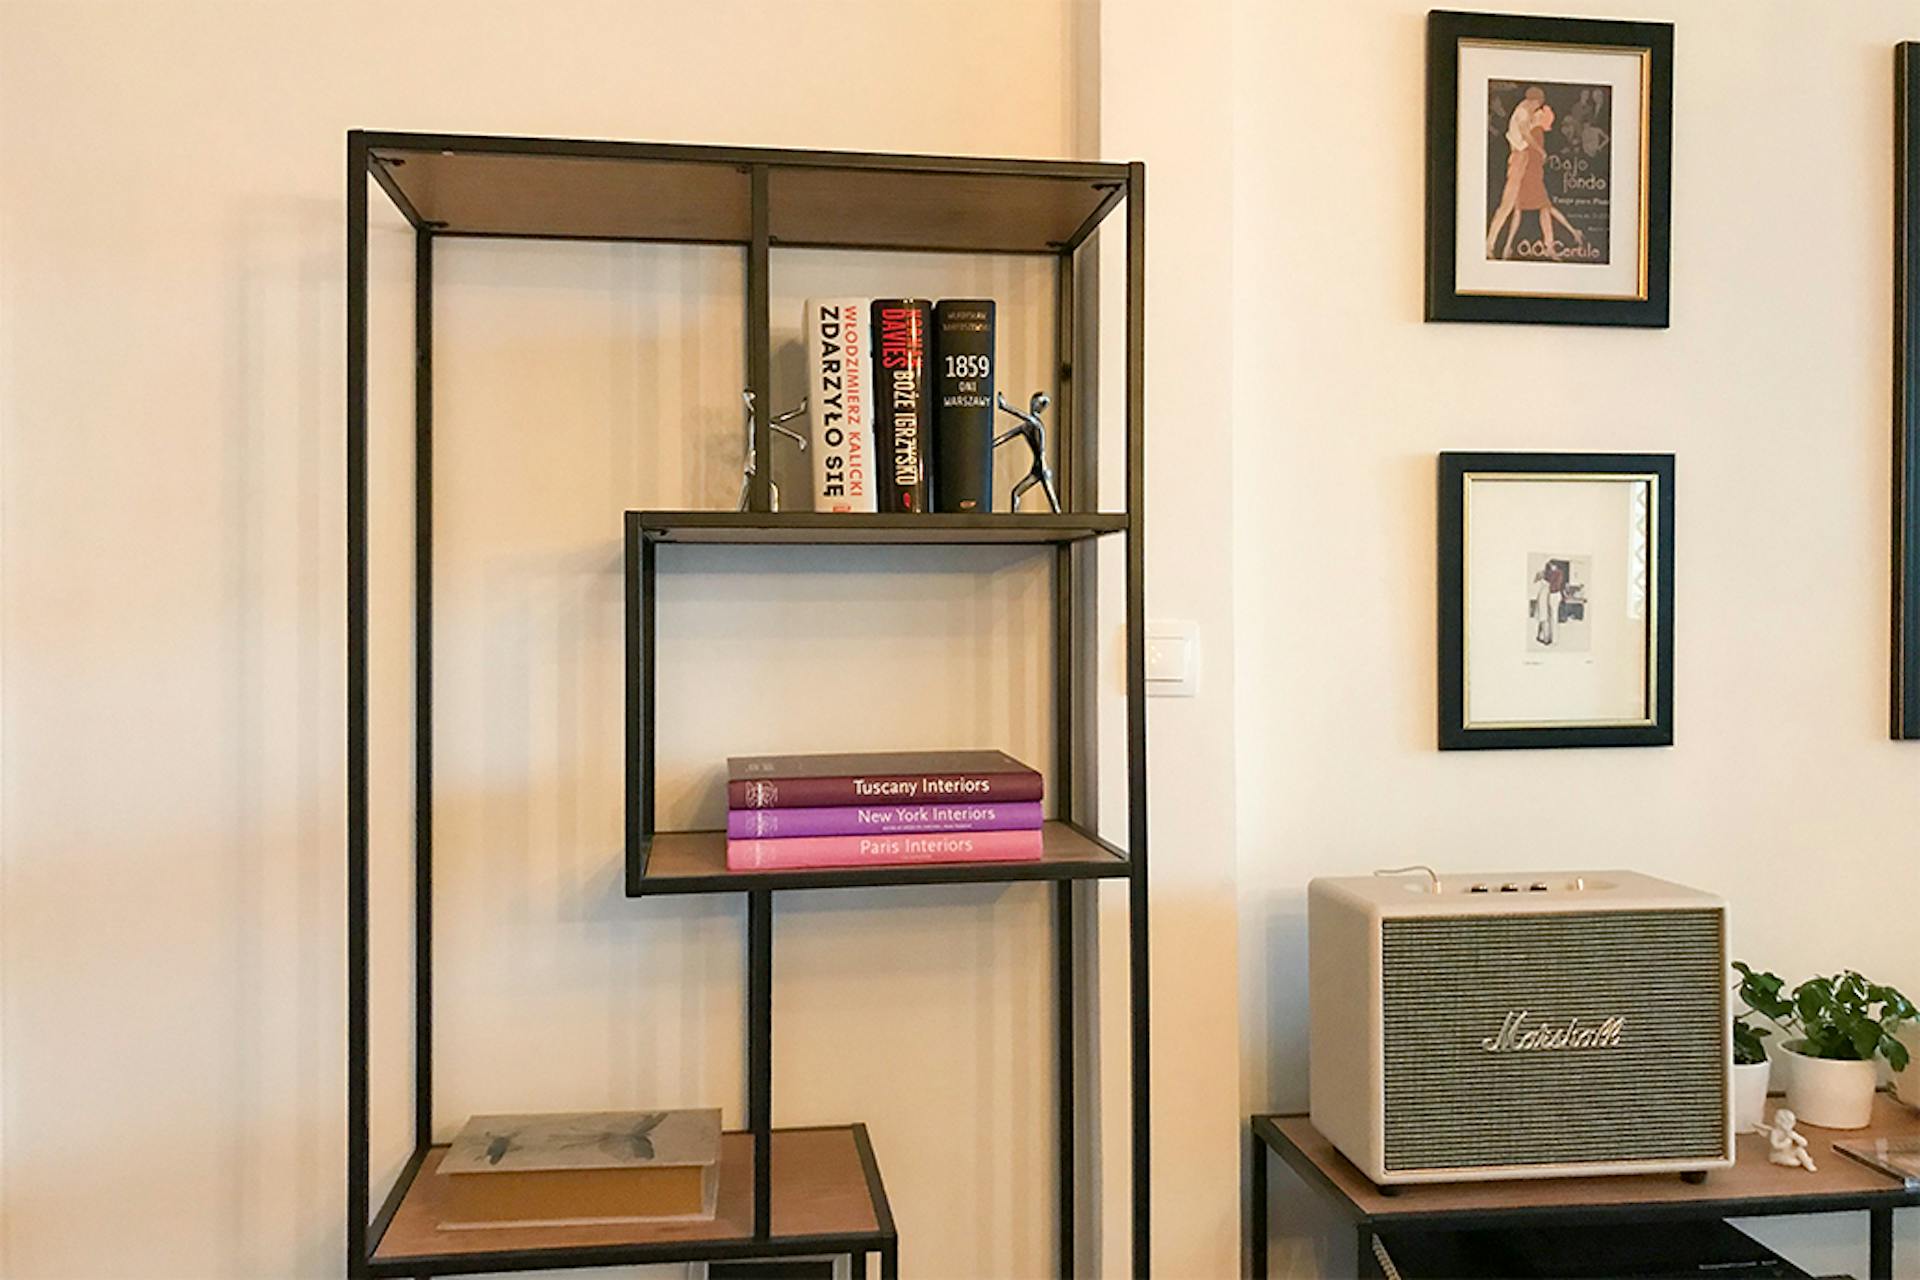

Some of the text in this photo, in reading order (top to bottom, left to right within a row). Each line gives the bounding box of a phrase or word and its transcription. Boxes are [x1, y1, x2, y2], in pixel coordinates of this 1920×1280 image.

[882, 308, 906, 369] DAVIES
[820, 306, 844, 447] ZDARZYŁO
[945, 355, 990, 378] 1859
[843, 306, 863, 497] WŁODZIMIERZ KALICKI
[893, 371, 919, 409] BOŻE
[823, 456, 844, 498] SIĘ
[853, 777, 990, 797] Tuscany Interiors
[858, 807, 996, 824] New York Interiors
[860, 838, 973, 854] Paris Interiors
[1482, 1010, 1626, 1052] Marshall
